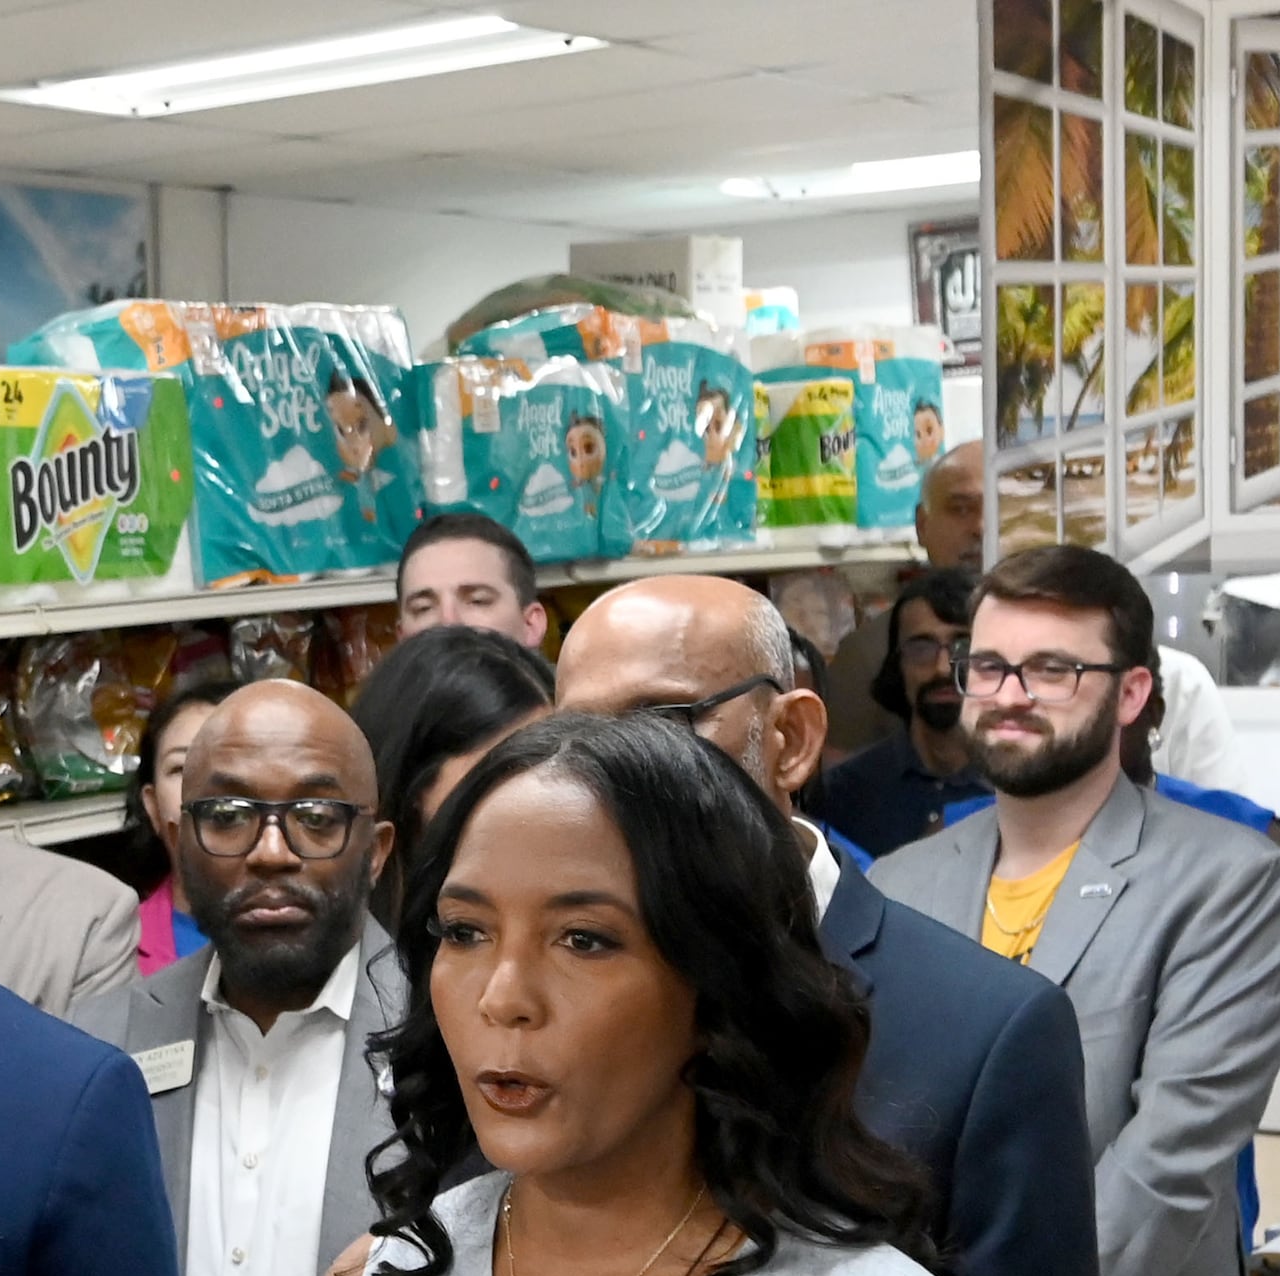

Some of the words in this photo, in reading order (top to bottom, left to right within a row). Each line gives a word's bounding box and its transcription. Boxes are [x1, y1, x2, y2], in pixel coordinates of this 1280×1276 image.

[231, 341, 321, 396] Angel
[643, 357, 694, 397] Angel
[1, 380, 23, 404] 24
[875, 384, 915, 416] Angel
[260, 386, 322, 438] Soft
[518, 396, 562, 431] Angel
[658, 393, 691, 433] Soft
[884, 412, 910, 440] Soft
[529, 430, 560, 459] Soft
[11, 425, 138, 551] Bounty
